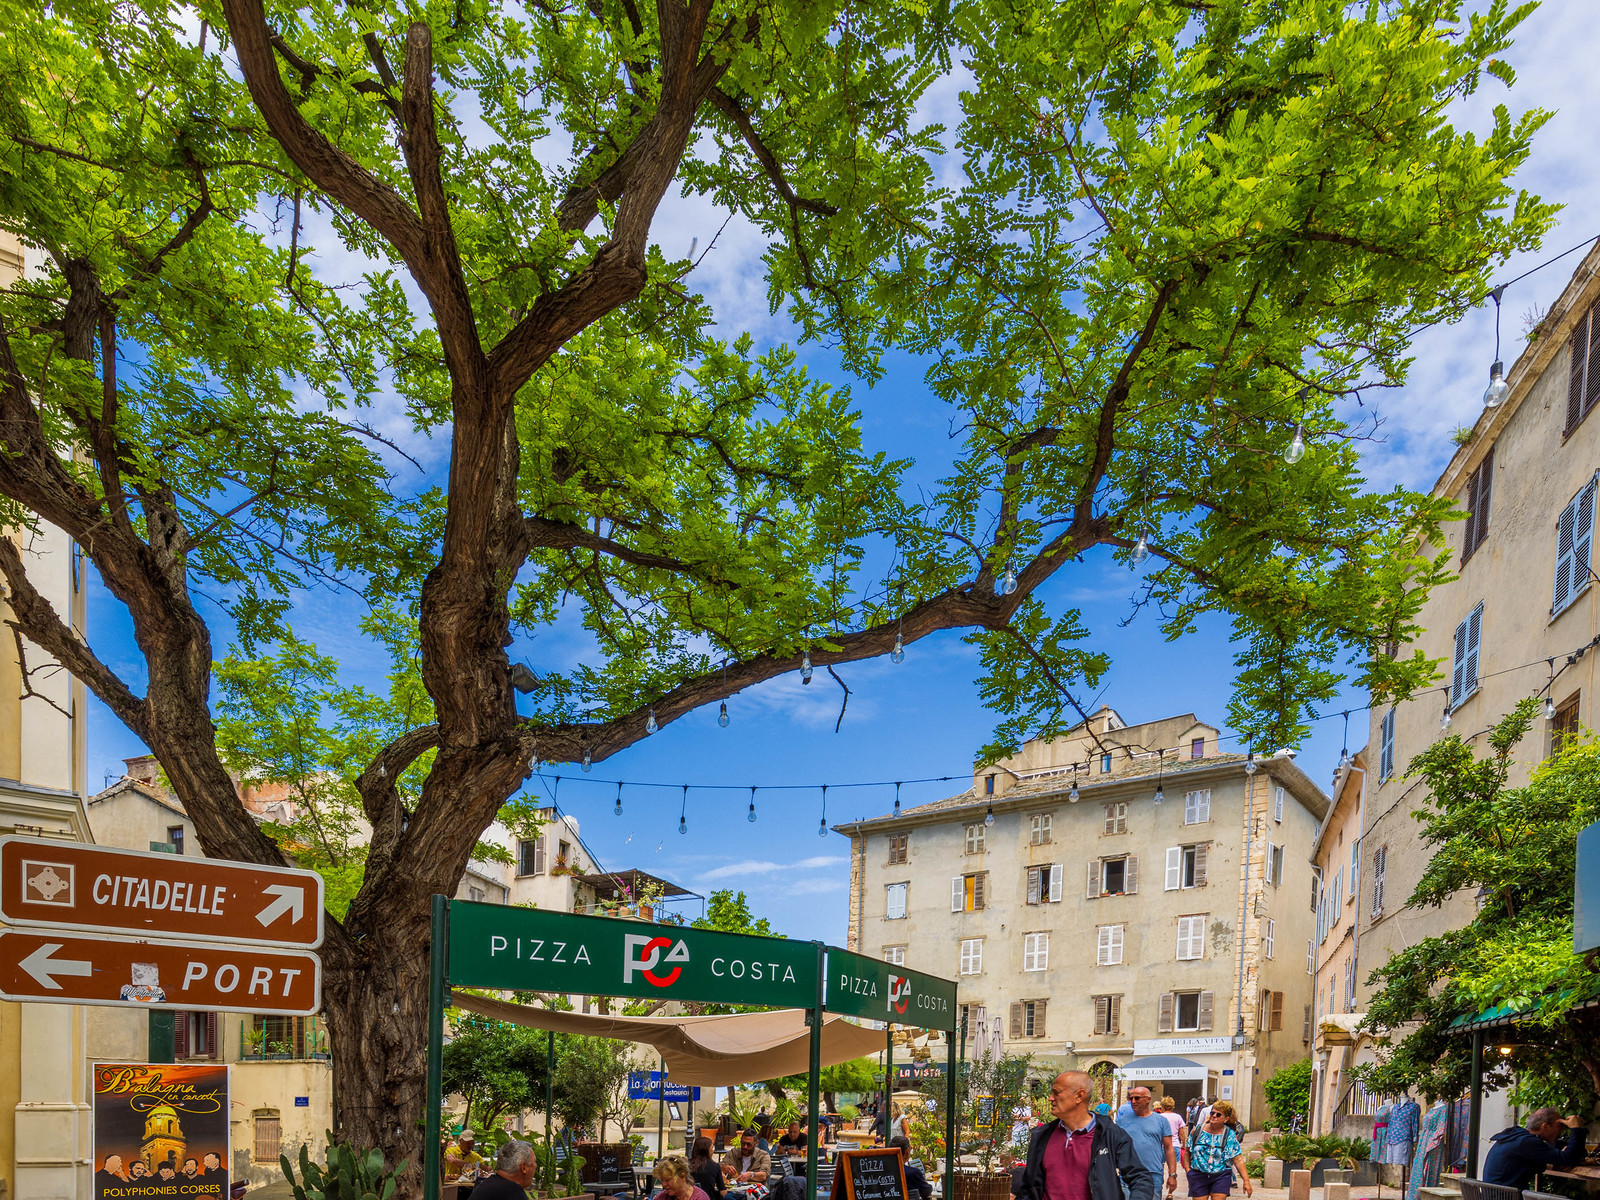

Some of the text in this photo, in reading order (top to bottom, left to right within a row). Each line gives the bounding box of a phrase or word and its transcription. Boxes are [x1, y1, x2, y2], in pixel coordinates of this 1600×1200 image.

[92, 874, 227, 916] CITADELLE
[491, 935, 591, 965] PIZZA
[711, 957, 796, 984] COSTA
[181, 961, 302, 997] PORT
[840, 974, 878, 998] PIZZA
[917, 993, 948, 1012] COSTA
[95, 1065, 197, 1097] Balagna
[899, 1068, 941, 1078] LA VISTA
[103, 1184, 221, 1197] POLYPHONIES CORSES
